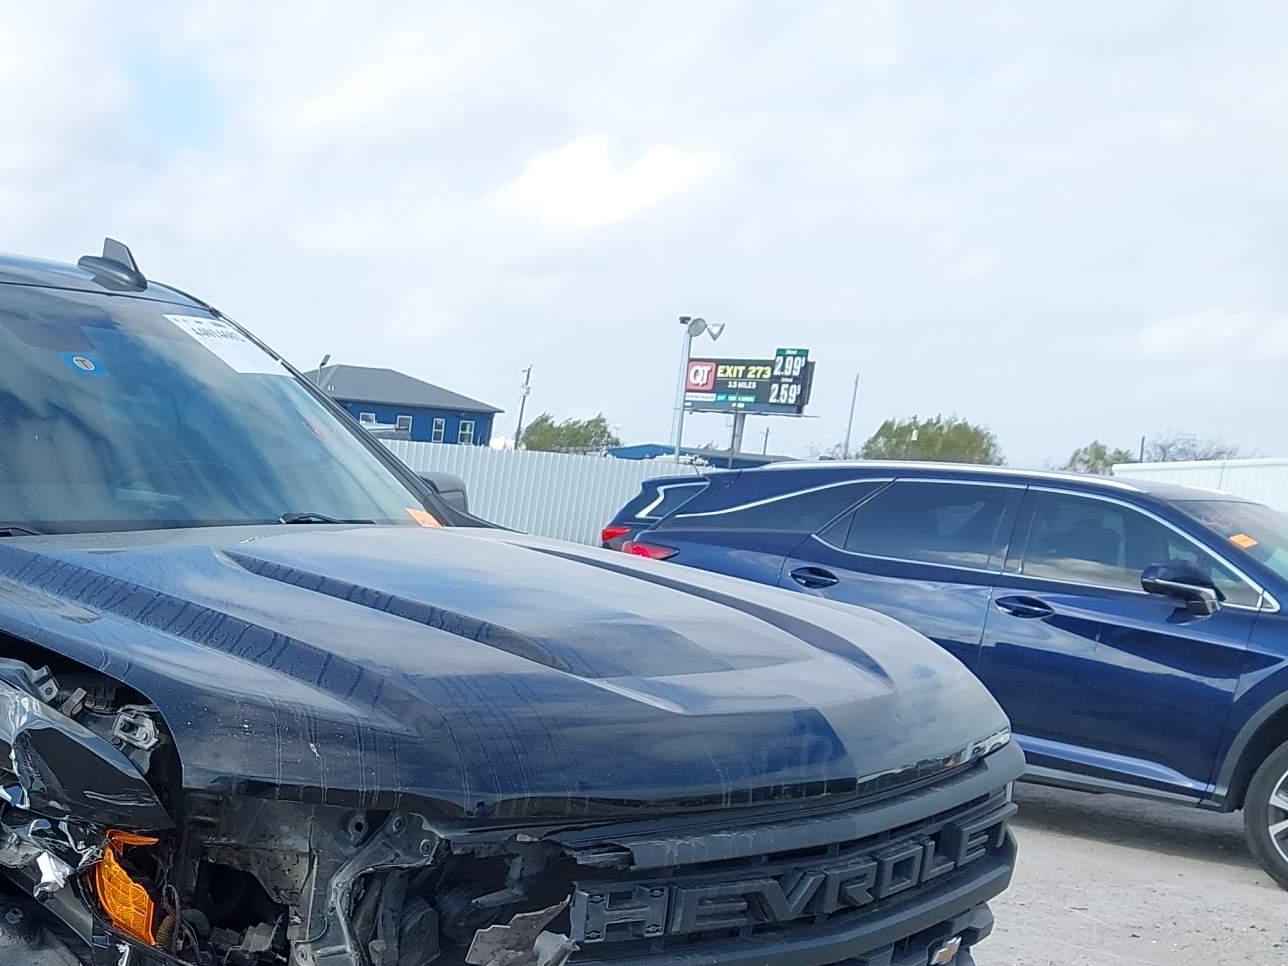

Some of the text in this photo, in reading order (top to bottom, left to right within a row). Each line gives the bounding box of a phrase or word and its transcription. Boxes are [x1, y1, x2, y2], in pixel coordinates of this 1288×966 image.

[689, 365, 712, 386] QT
[717, 365, 772, 379] EXIT 273
